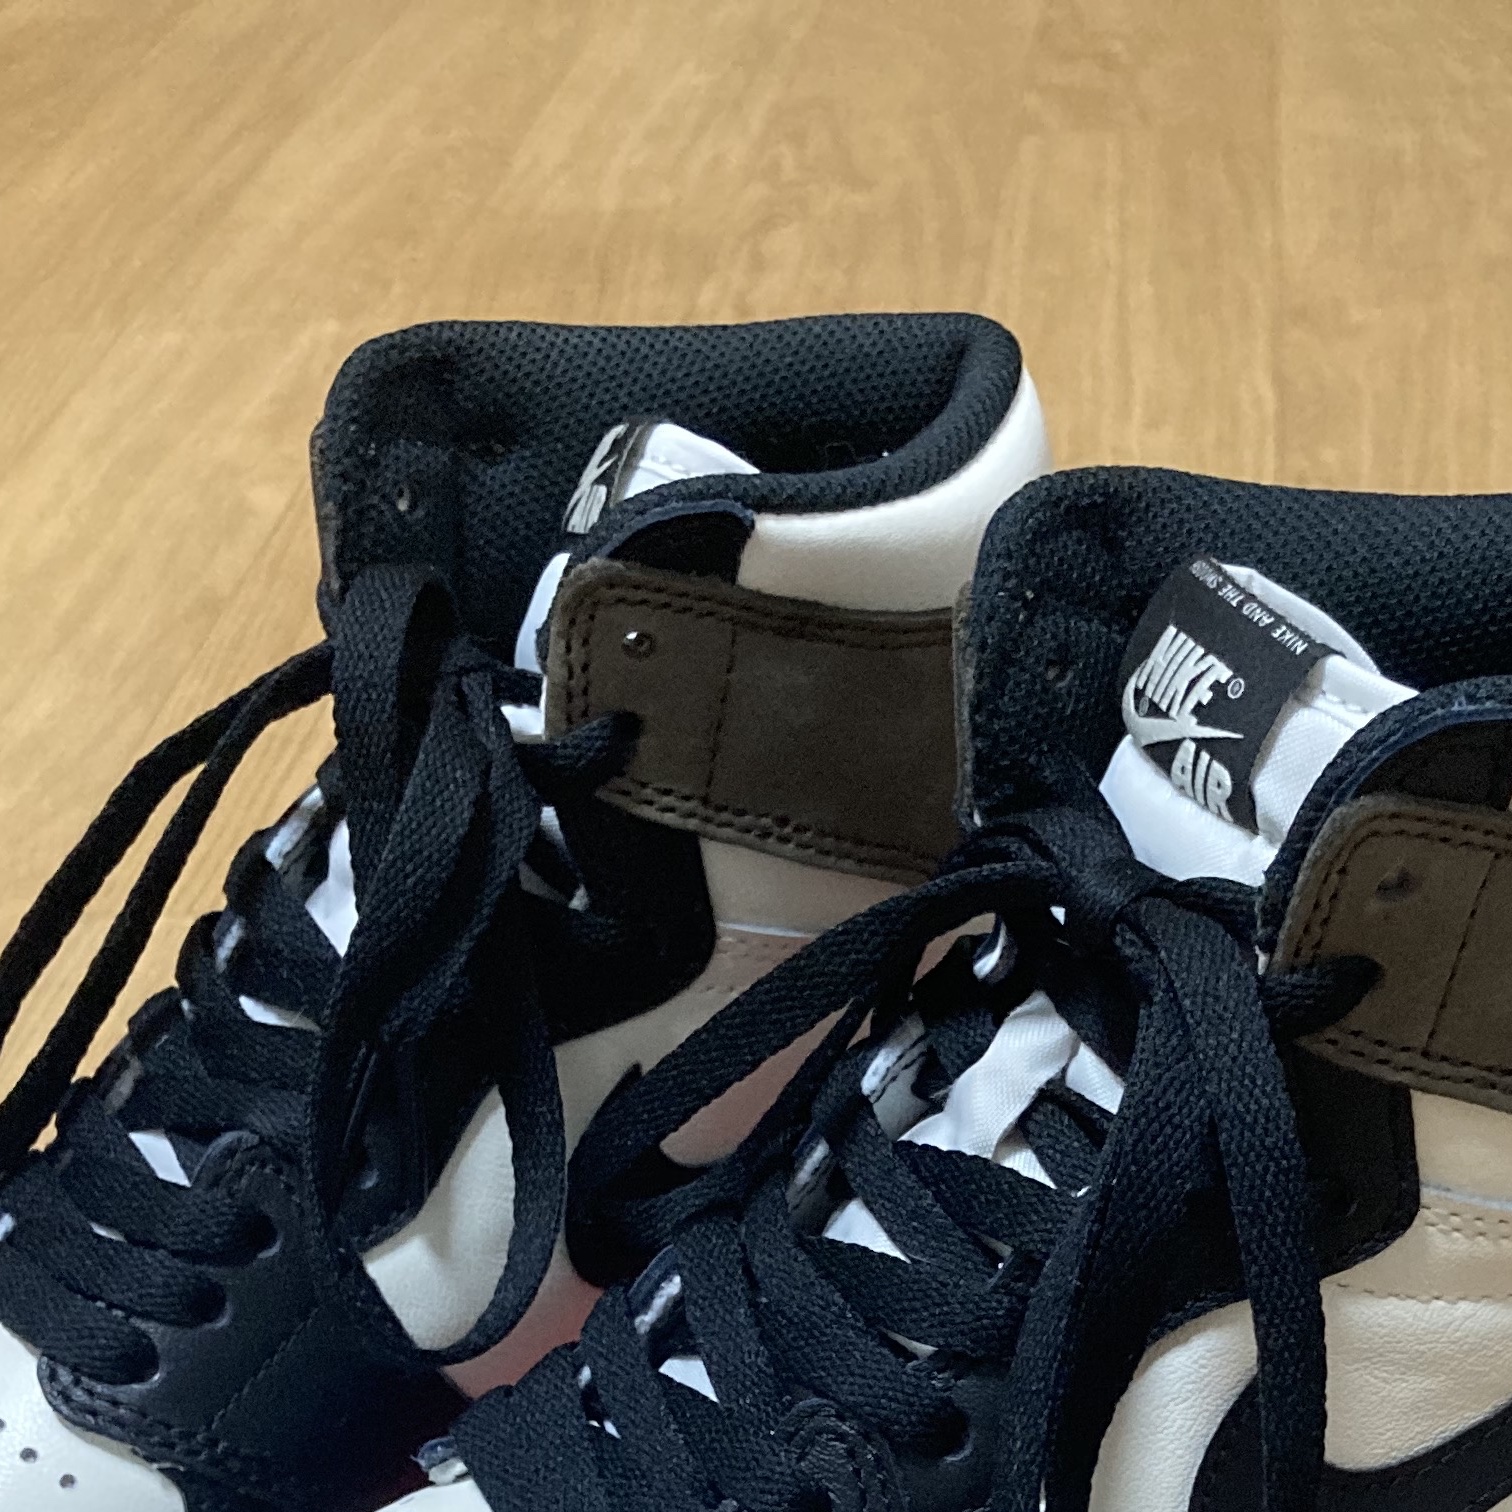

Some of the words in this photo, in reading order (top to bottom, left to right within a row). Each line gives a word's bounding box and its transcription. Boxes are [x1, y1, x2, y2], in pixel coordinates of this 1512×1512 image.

[1217, 584, 1244, 607] THE
[1242, 602, 1275, 627] AND
[1270, 625, 1308, 655] NIKE
[1136, 624, 1234, 725] NIKE
[1171, 738, 1234, 823] AIR
